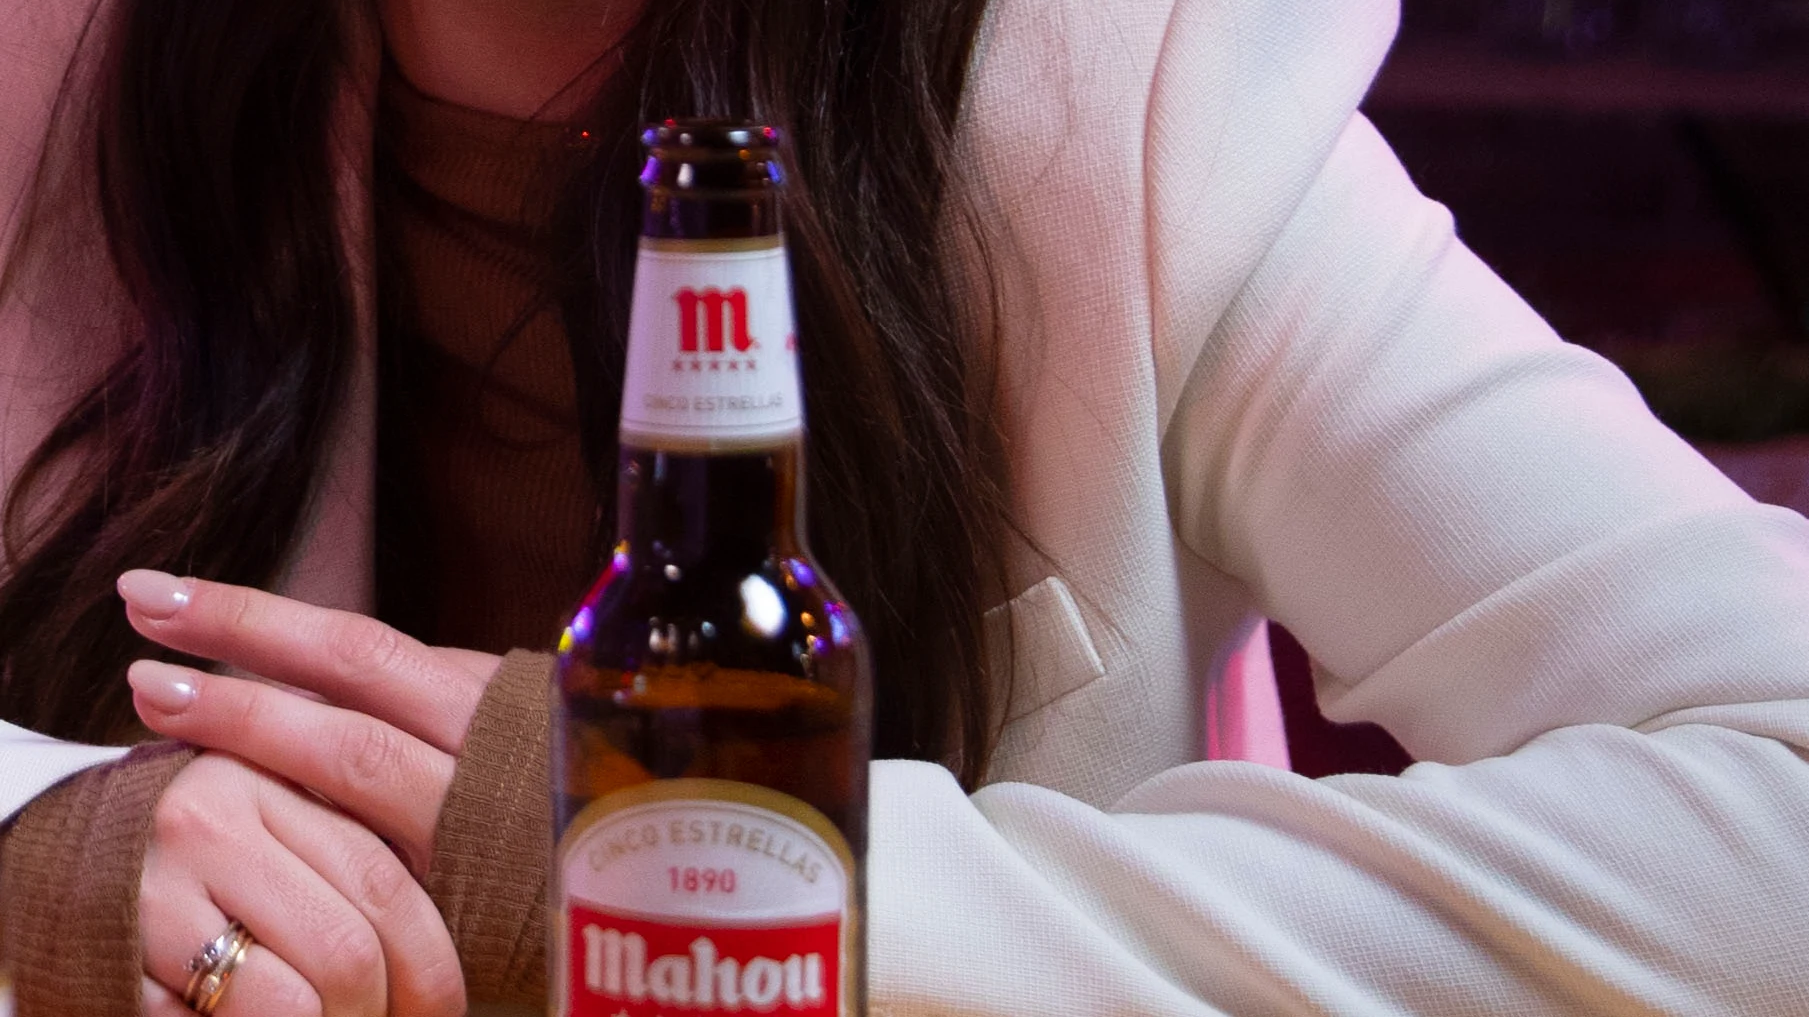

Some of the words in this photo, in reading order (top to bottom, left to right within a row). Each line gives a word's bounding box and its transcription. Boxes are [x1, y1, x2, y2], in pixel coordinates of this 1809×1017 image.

[694, 391, 783, 411] ESTRELLAS
[588, 823, 659, 872] CINCO
[668, 819, 824, 884] ESTRELLAS
[667, 865, 737, 894] 1890
[581, 922, 827, 1010] Mahou
